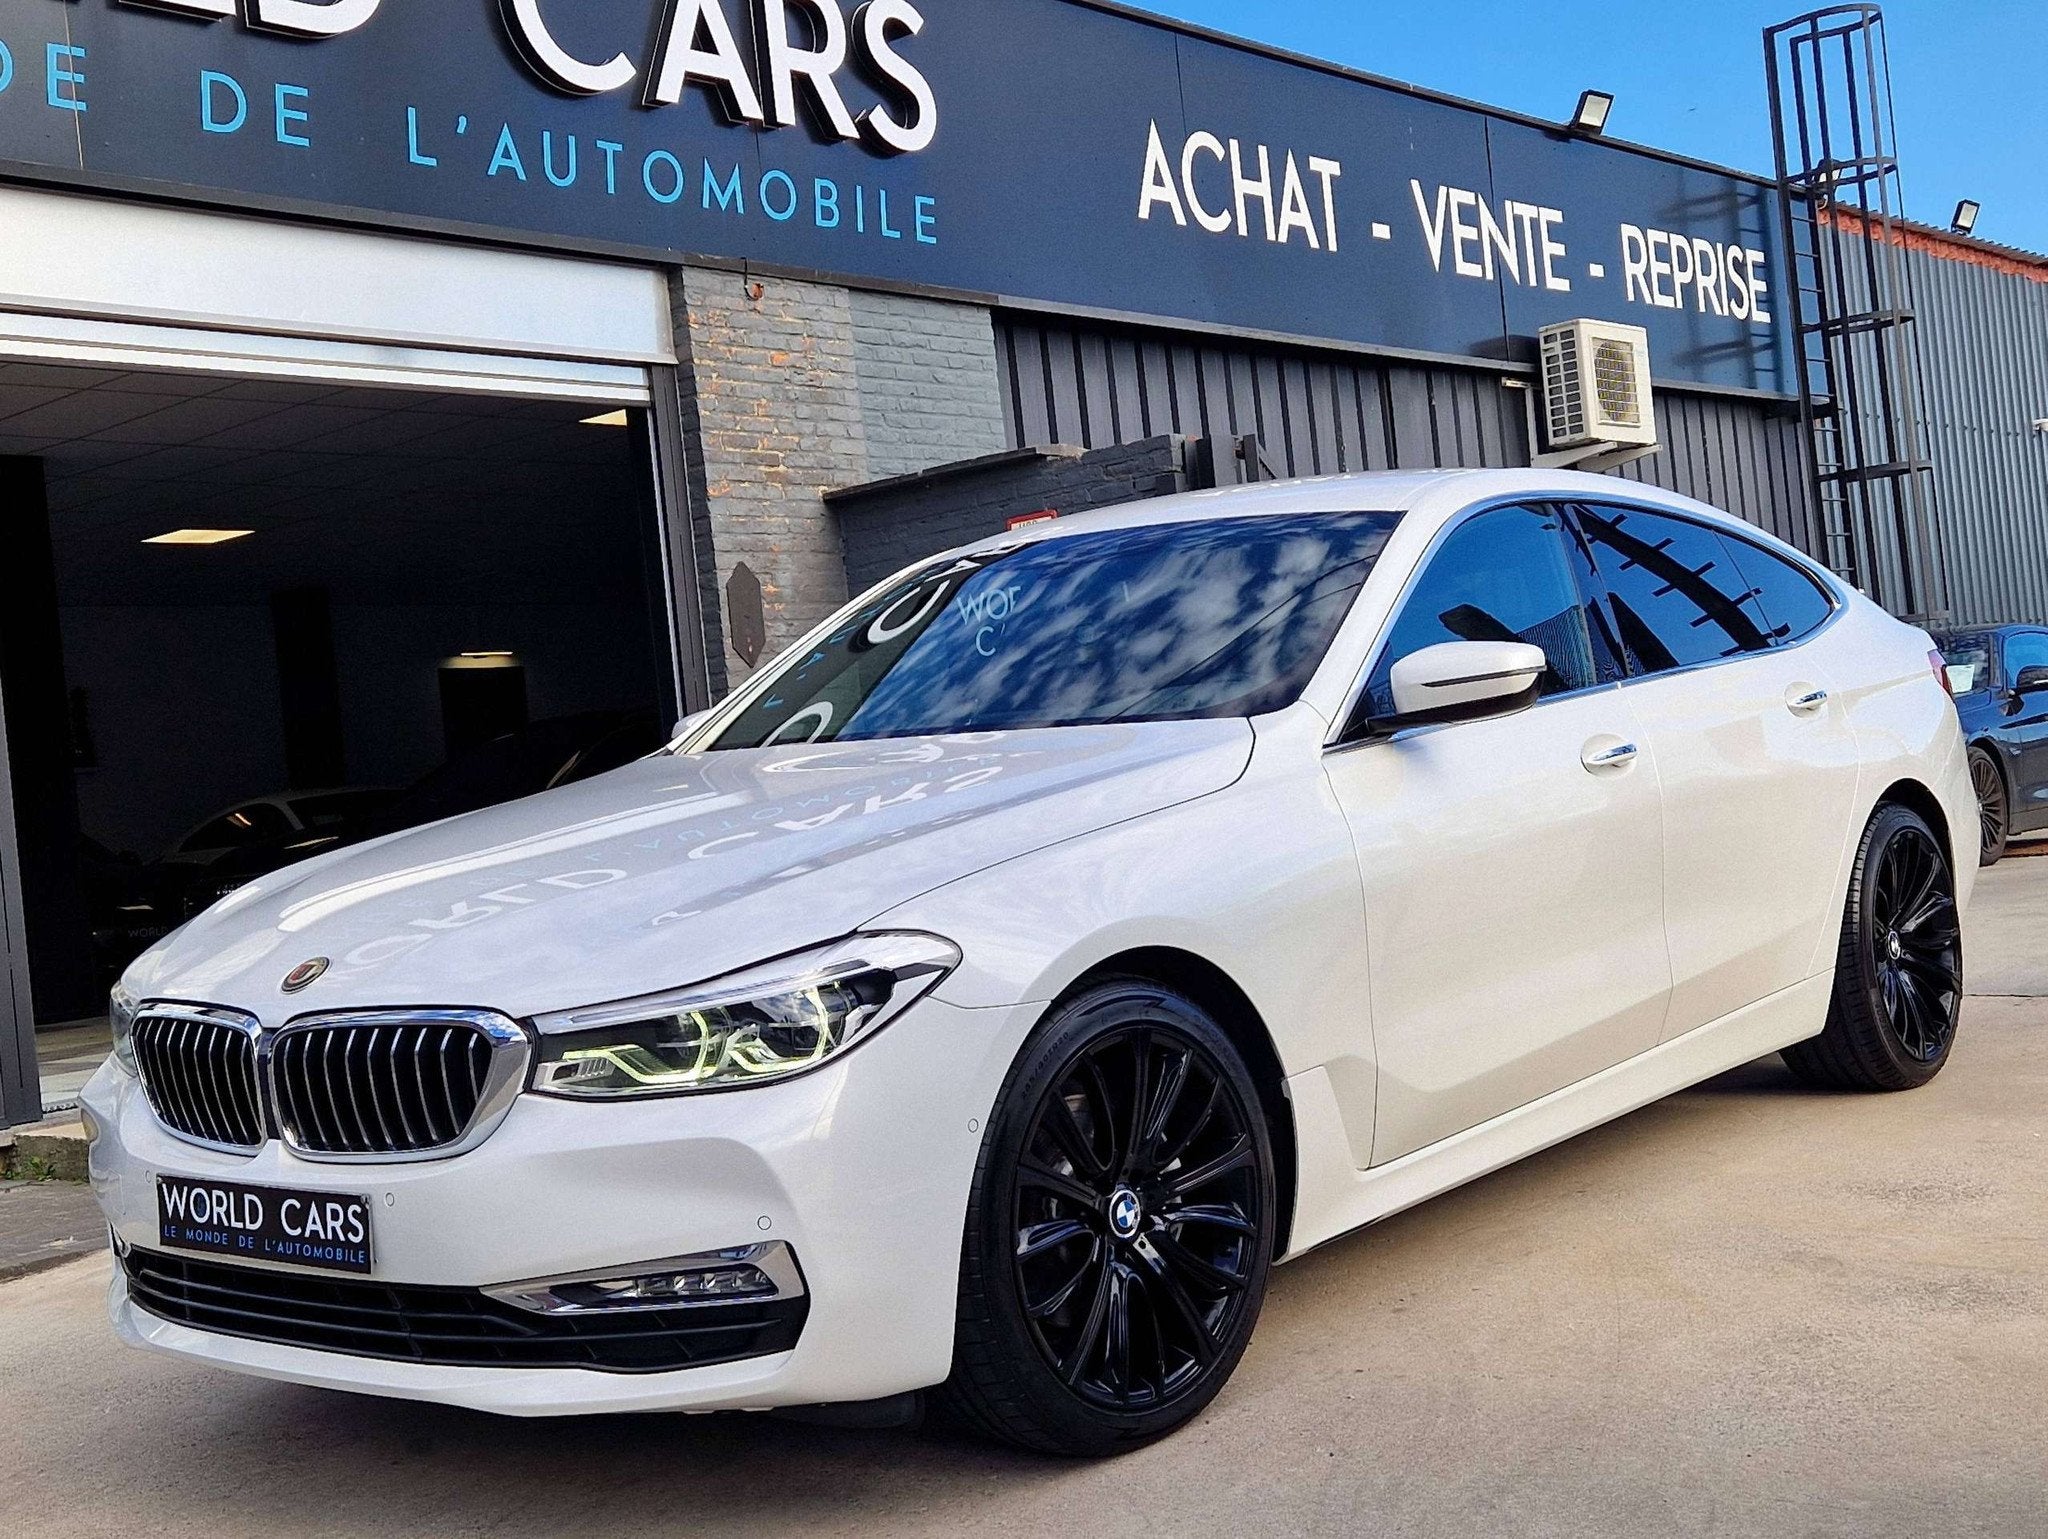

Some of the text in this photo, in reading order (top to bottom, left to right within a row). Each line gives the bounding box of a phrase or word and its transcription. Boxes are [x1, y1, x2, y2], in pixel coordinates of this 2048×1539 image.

[200, 69, 311, 148] DE
[406, 105, 938, 246] L'AUTOMOBILE
[1138, 118, 1341, 252] ACHAT
[1410, 179, 1571, 292] VENTE
[1620, 223, 1771, 323] REPRISE
[162, 1182, 364, 1243] WORLD CARS
[164, 1226, 366, 1265] LE MONDE DE L'AUTOMOBILE
